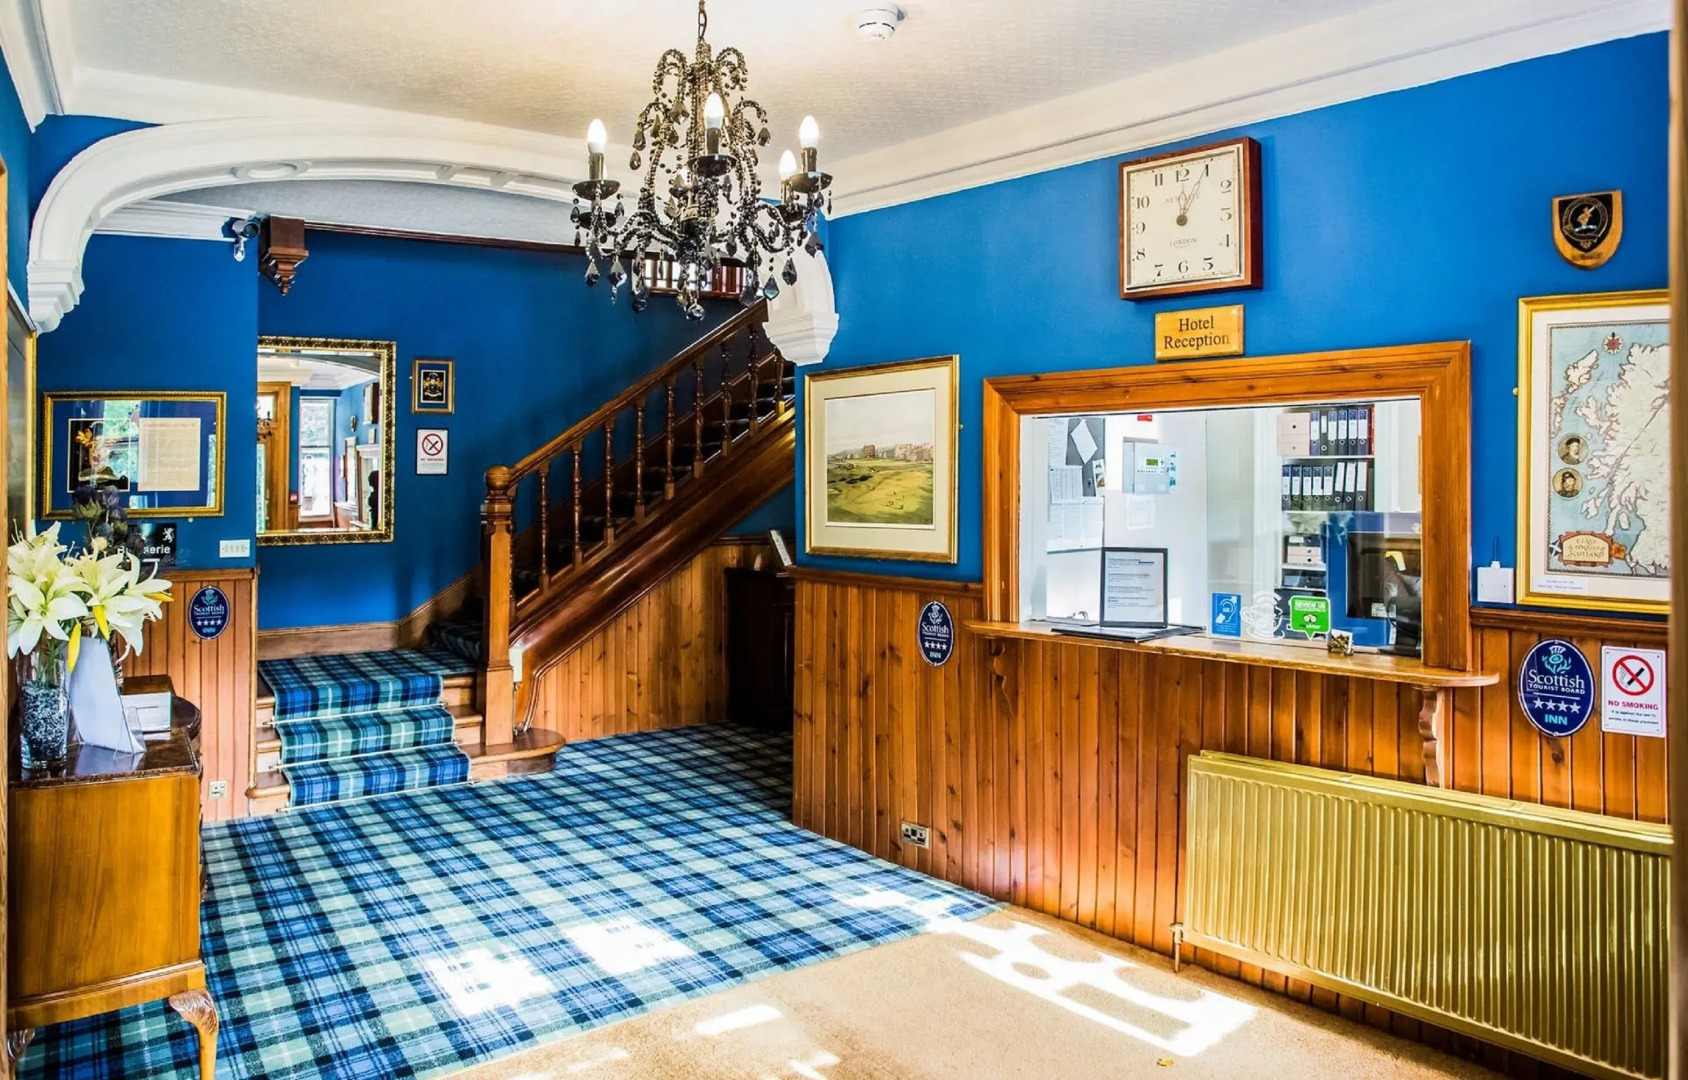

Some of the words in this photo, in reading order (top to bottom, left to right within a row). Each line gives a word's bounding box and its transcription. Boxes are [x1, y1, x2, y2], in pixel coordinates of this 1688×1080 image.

[1155, 173, 1163, 187] 11
[1175, 168, 1190, 182] 12
[1220, 180, 1232, 194] 2
[1137, 196, 1150, 209] 10
[1220, 207, 1232, 221] 3
[1135, 222, 1146, 235] 9
[1169, 237, 1197, 246] LONDON
[1219, 234, 1233, 247] 4
[1135, 248, 1146, 261] 8
[1154, 263, 1163, 277] 7
[1178, 260, 1189, 273] 6
[1202, 257, 1214, 271] 5
[1178, 315, 1214, 332] Hotel
[1164, 332, 1230, 350] Reception
[193, 604, 225, 612] Scottish
[921, 621, 949, 635] Scottish
[1528, 668, 1585, 689] Scottish
[1529, 683, 1558, 691] TOURIST
[1561, 687, 1585, 695] BOARD
[1621, 701, 1659, 711] SMOKING
[1544, 714, 1568, 725] INN
